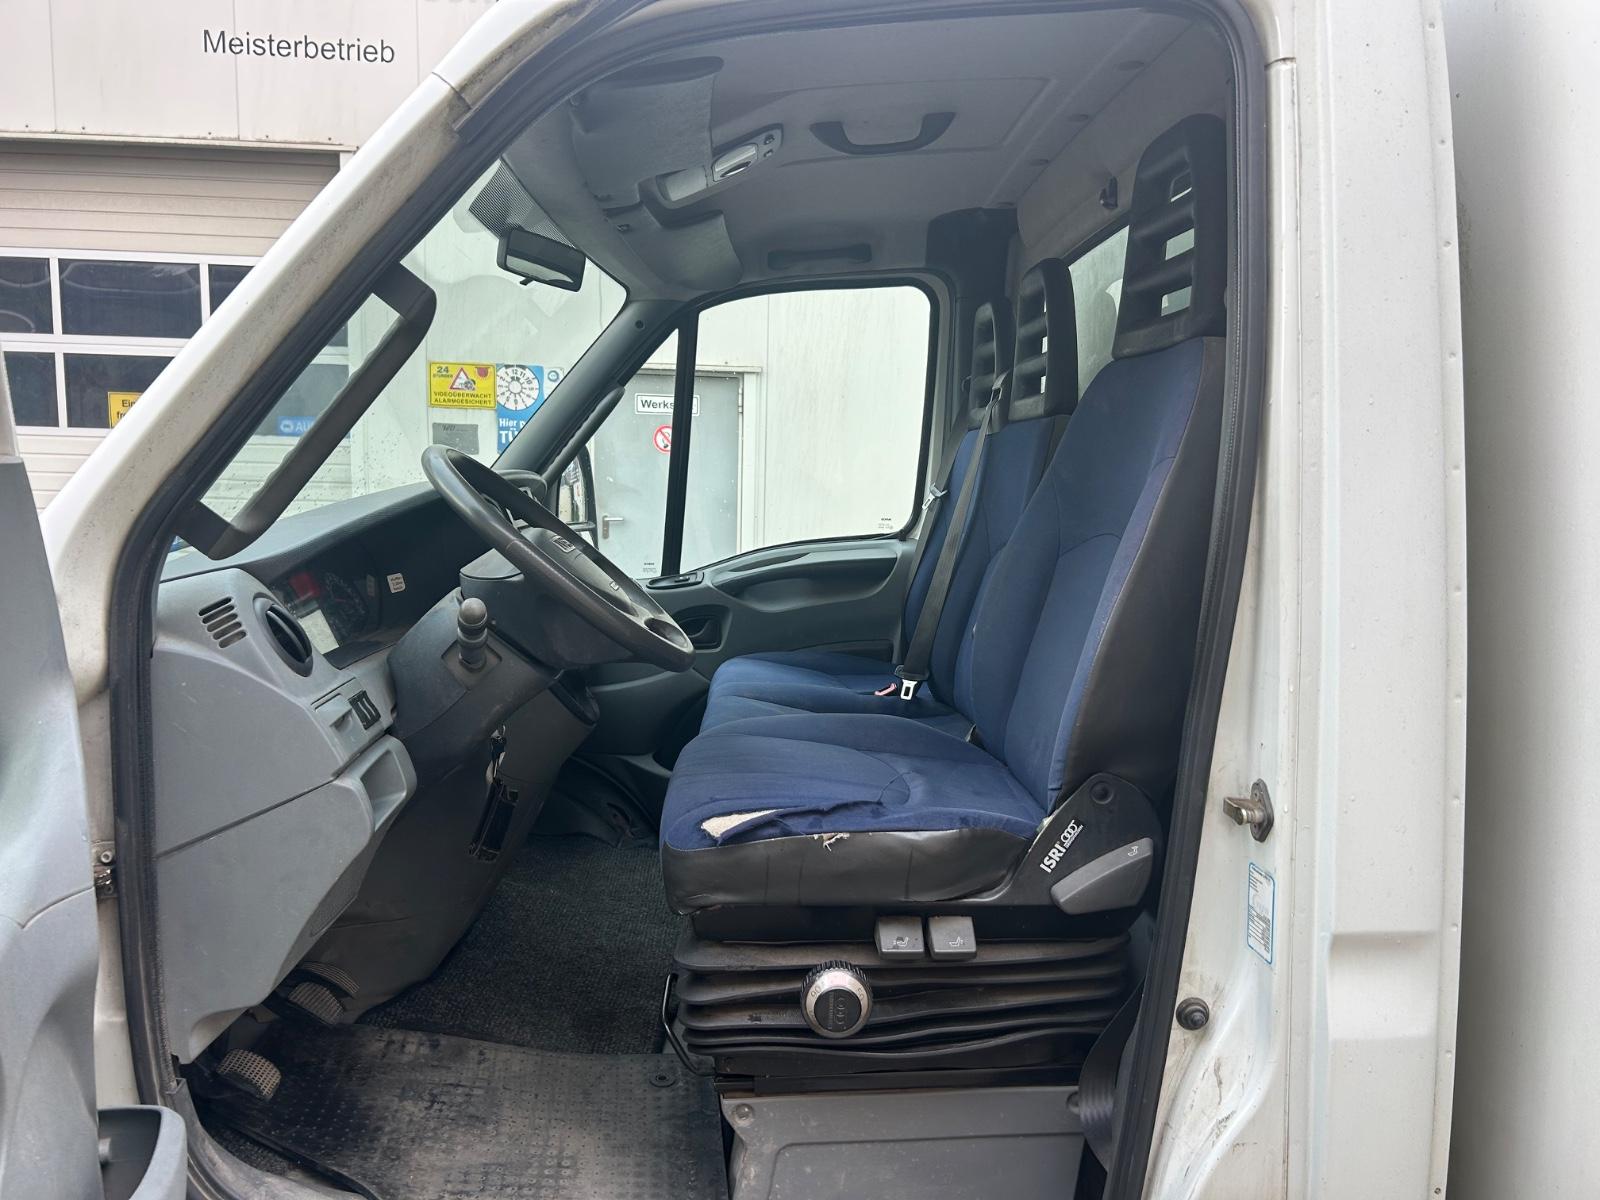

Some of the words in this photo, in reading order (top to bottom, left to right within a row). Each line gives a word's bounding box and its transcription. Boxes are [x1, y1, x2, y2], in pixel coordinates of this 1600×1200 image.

[203, 29, 395, 63] Meisterbetrieb
[436, 366, 449, 374] 24
[434, 397, 492, 405] ALARMGESICHERT
[499, 418, 517, 427] Hier
[1040, 843, 1067, 873] ISRI
